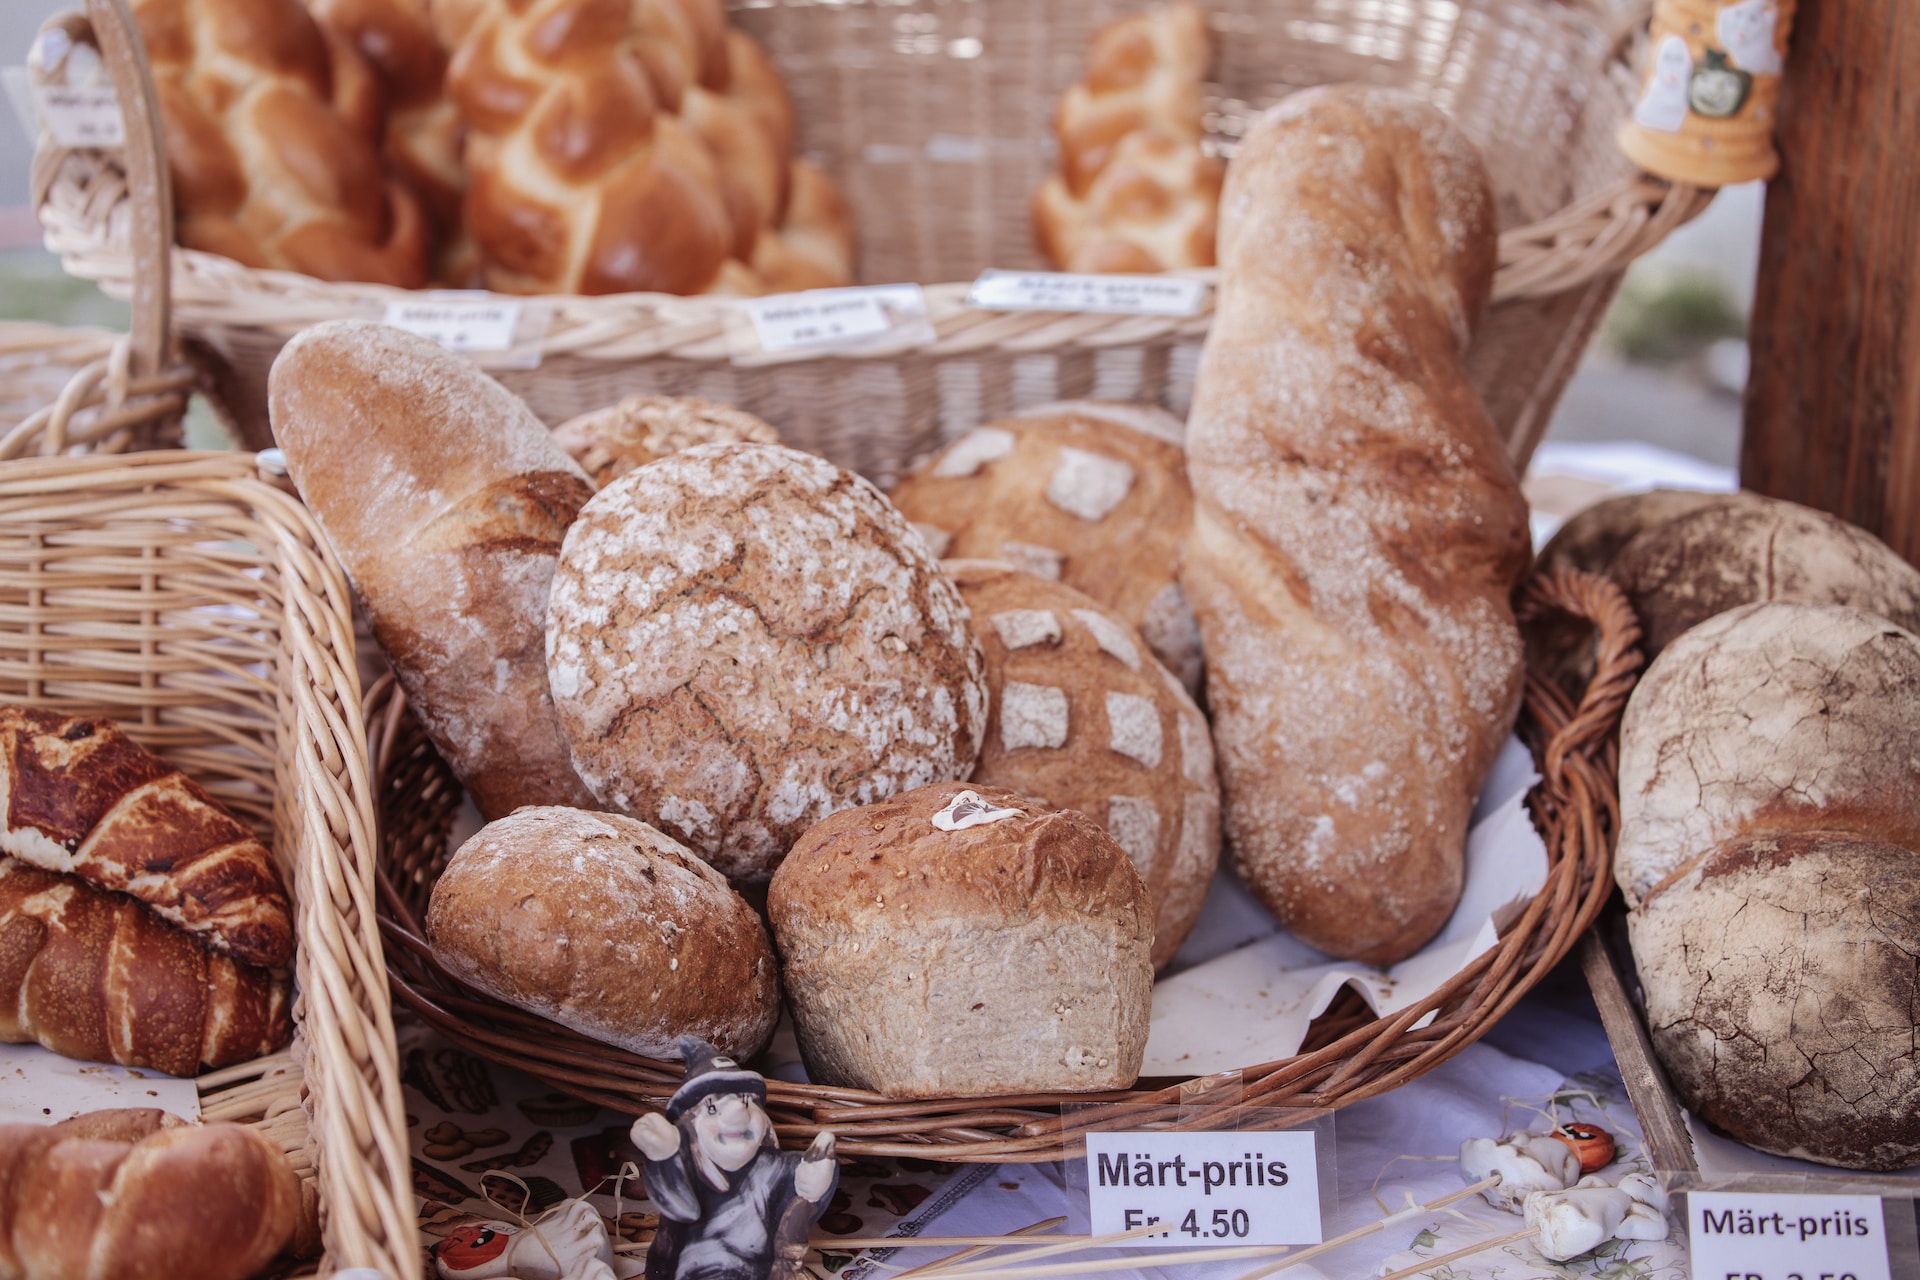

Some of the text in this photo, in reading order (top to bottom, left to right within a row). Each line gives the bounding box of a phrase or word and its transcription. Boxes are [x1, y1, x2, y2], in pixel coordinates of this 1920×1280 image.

[1097, 1152, 1289, 1196] Märt-priis
[1124, 1208, 1250, 1238] Fr. 4.50
[1702, 1208, 1870, 1242] Märt-priis
